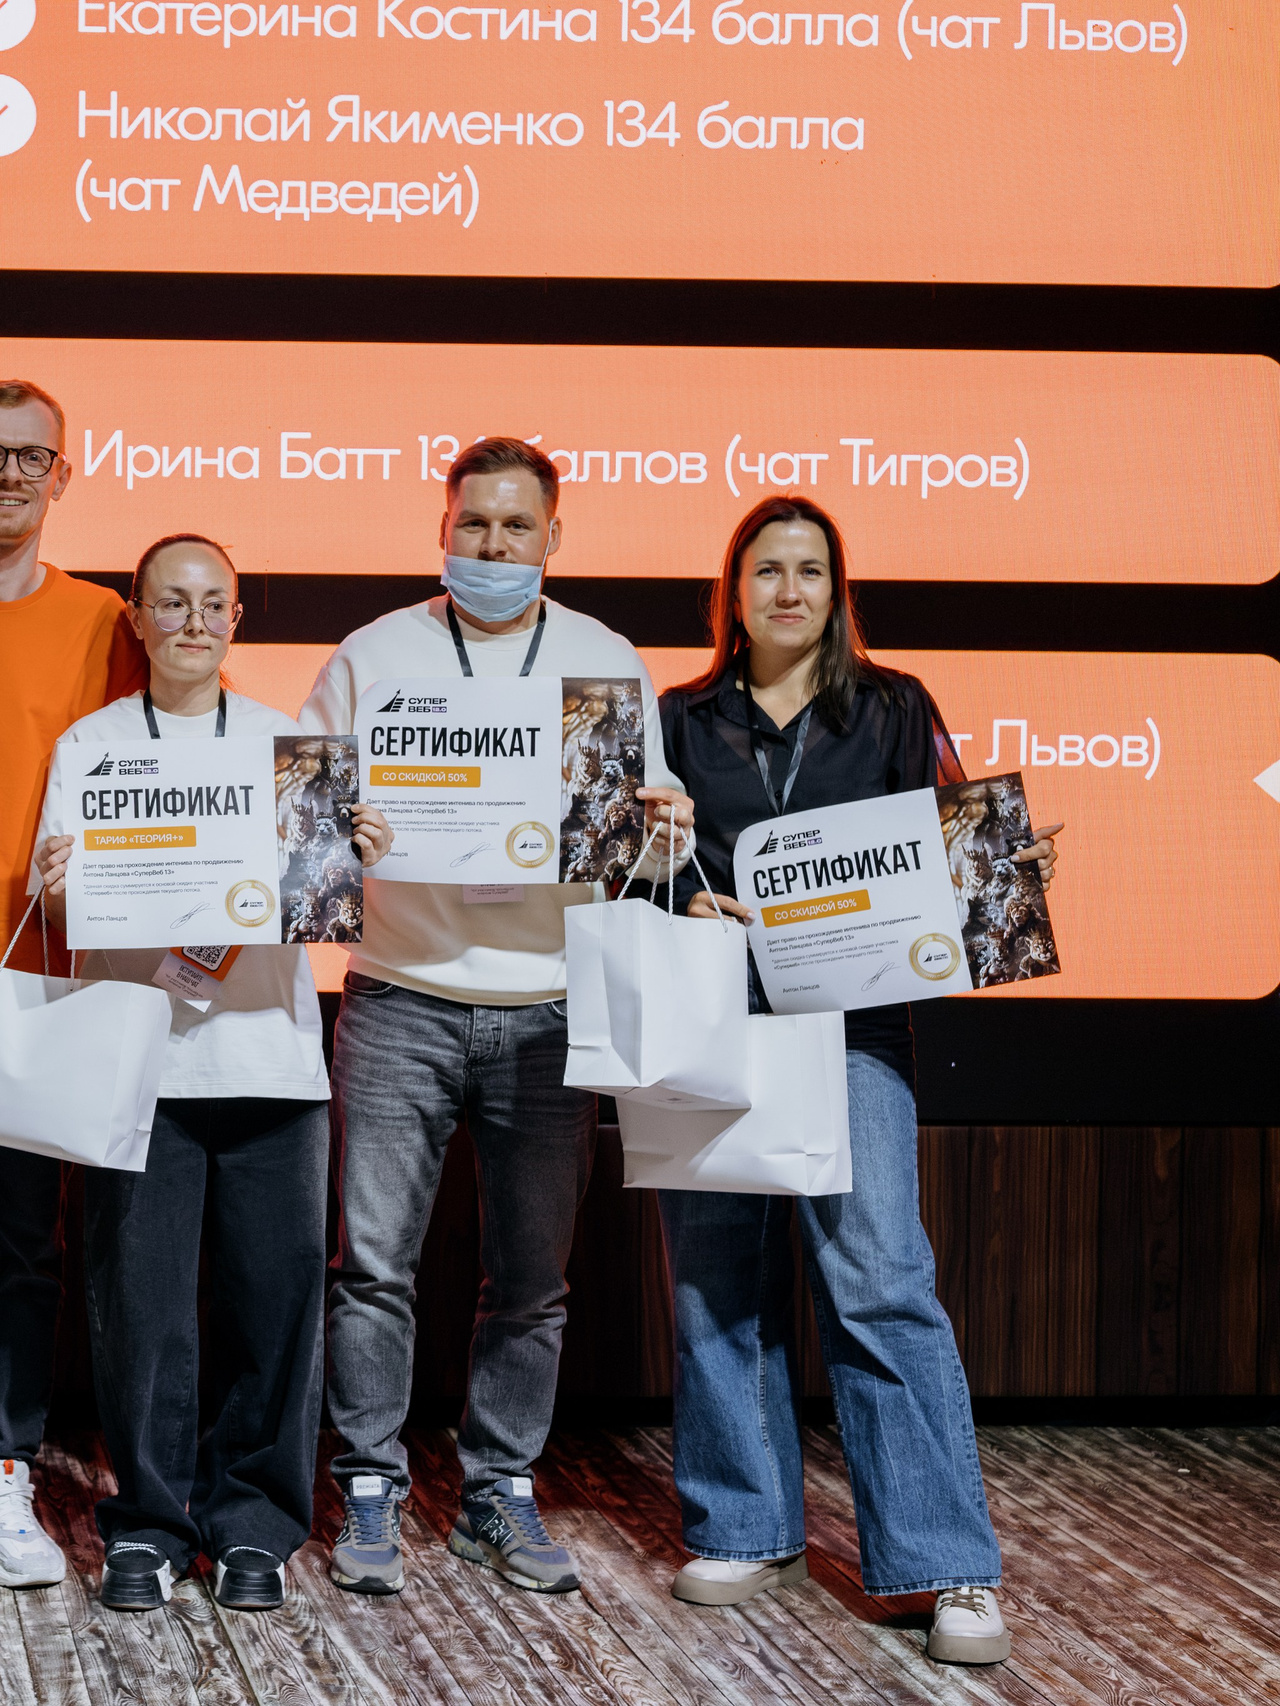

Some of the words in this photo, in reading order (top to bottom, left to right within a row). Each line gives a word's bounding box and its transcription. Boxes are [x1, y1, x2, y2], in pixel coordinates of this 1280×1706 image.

[78, 0, 356, 48] Екатерина
[377, 0, 597, 43] Костина
[618, 0, 696, 43] 134
[711, 0, 879, 47] балла
[897, 0, 1001, 60] (чат
[1013, 3, 1188, 66] Львов)
[78, 91, 311, 142] Николай
[326, 94, 585, 147] Якименко
[604, 99, 681, 148] 134
[697, 100, 865, 150] балла
[75, 159, 181, 222] (чат
[193, 163, 480, 228] Медведей)
[84, 429, 260, 490] Ирина
[280, 431, 402, 481] Батт
[417, 434, 486, 482] 13
[524, 435, 708, 485] аллов
[724, 434, 829, 497] (чат
[839, 437, 1030, 500] Тигров)
[408, 697, 447, 705] СУПЕР
[408, 705, 431, 713] ВЕБ
[370, 726, 541, 757] СЕРТИФИКАТ
[985, 717, 1161, 780] Львов)
[118, 759, 159, 767] СУПЕР
[118, 767, 143, 775] ВЕБ
[382, 772, 397, 781] СО
[398, 771, 446, 783] СКИДКОЙ
[448, 772, 468, 782] 50%
[82, 785, 254, 821] СЕРТИФИКАТ
[94, 835, 127, 846] ТАРИФ
[129, 833, 184, 844] «ТЕОРИЯ+»
[782, 829, 821, 843] СУПЕР
[783, 841, 807, 851] ВЕБ
[752, 840, 922, 899] СЕРТИФИКАТ
[774, 911, 788, 921] СО
[790, 900, 837, 918] СКИДКОЙ
[837, 898, 858, 910] 50%
